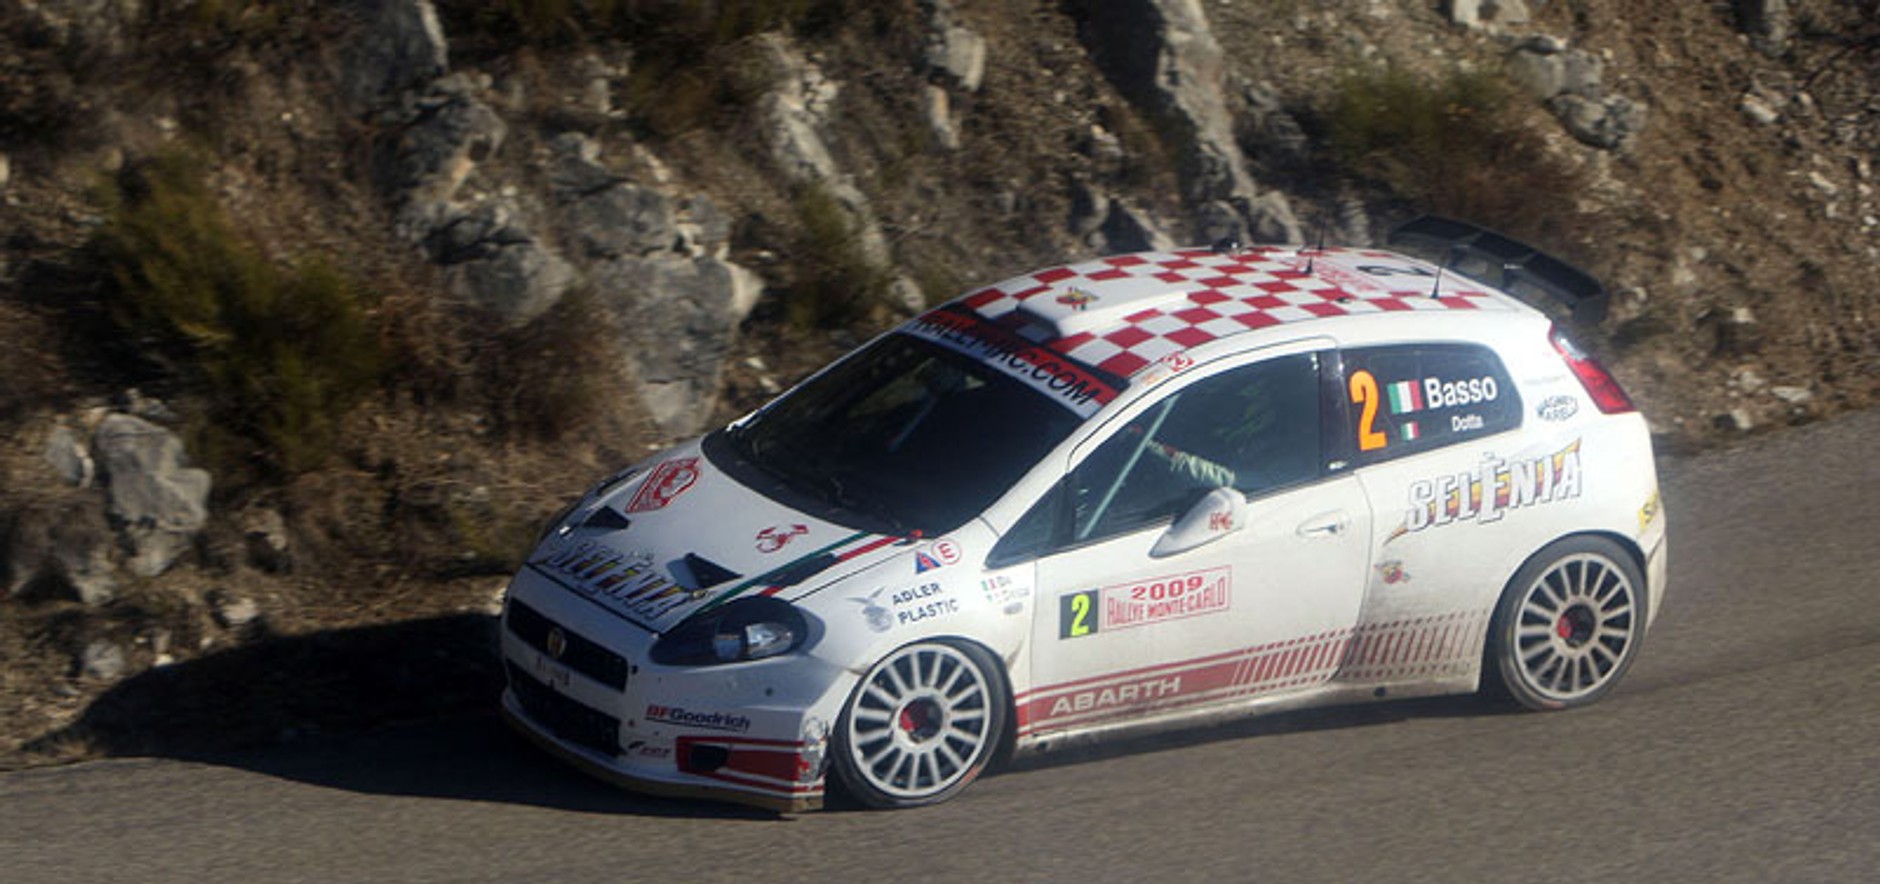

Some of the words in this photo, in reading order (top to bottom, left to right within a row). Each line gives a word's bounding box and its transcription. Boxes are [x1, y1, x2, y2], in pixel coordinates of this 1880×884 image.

[1349, 369, 1388, 452] 2
[1424, 375, 1498, 410] Basso
[939, 542, 955, 560] E
[892, 582, 943, 605] ADLER
[1130, 576, 1204, 600] 2009
[898, 599, 960, 625] PLASTIC
[1070, 593, 1091, 637] 2
[1050, 676, 1182, 717] ABARTH
[646, 704, 752, 732] BFGoodrich
